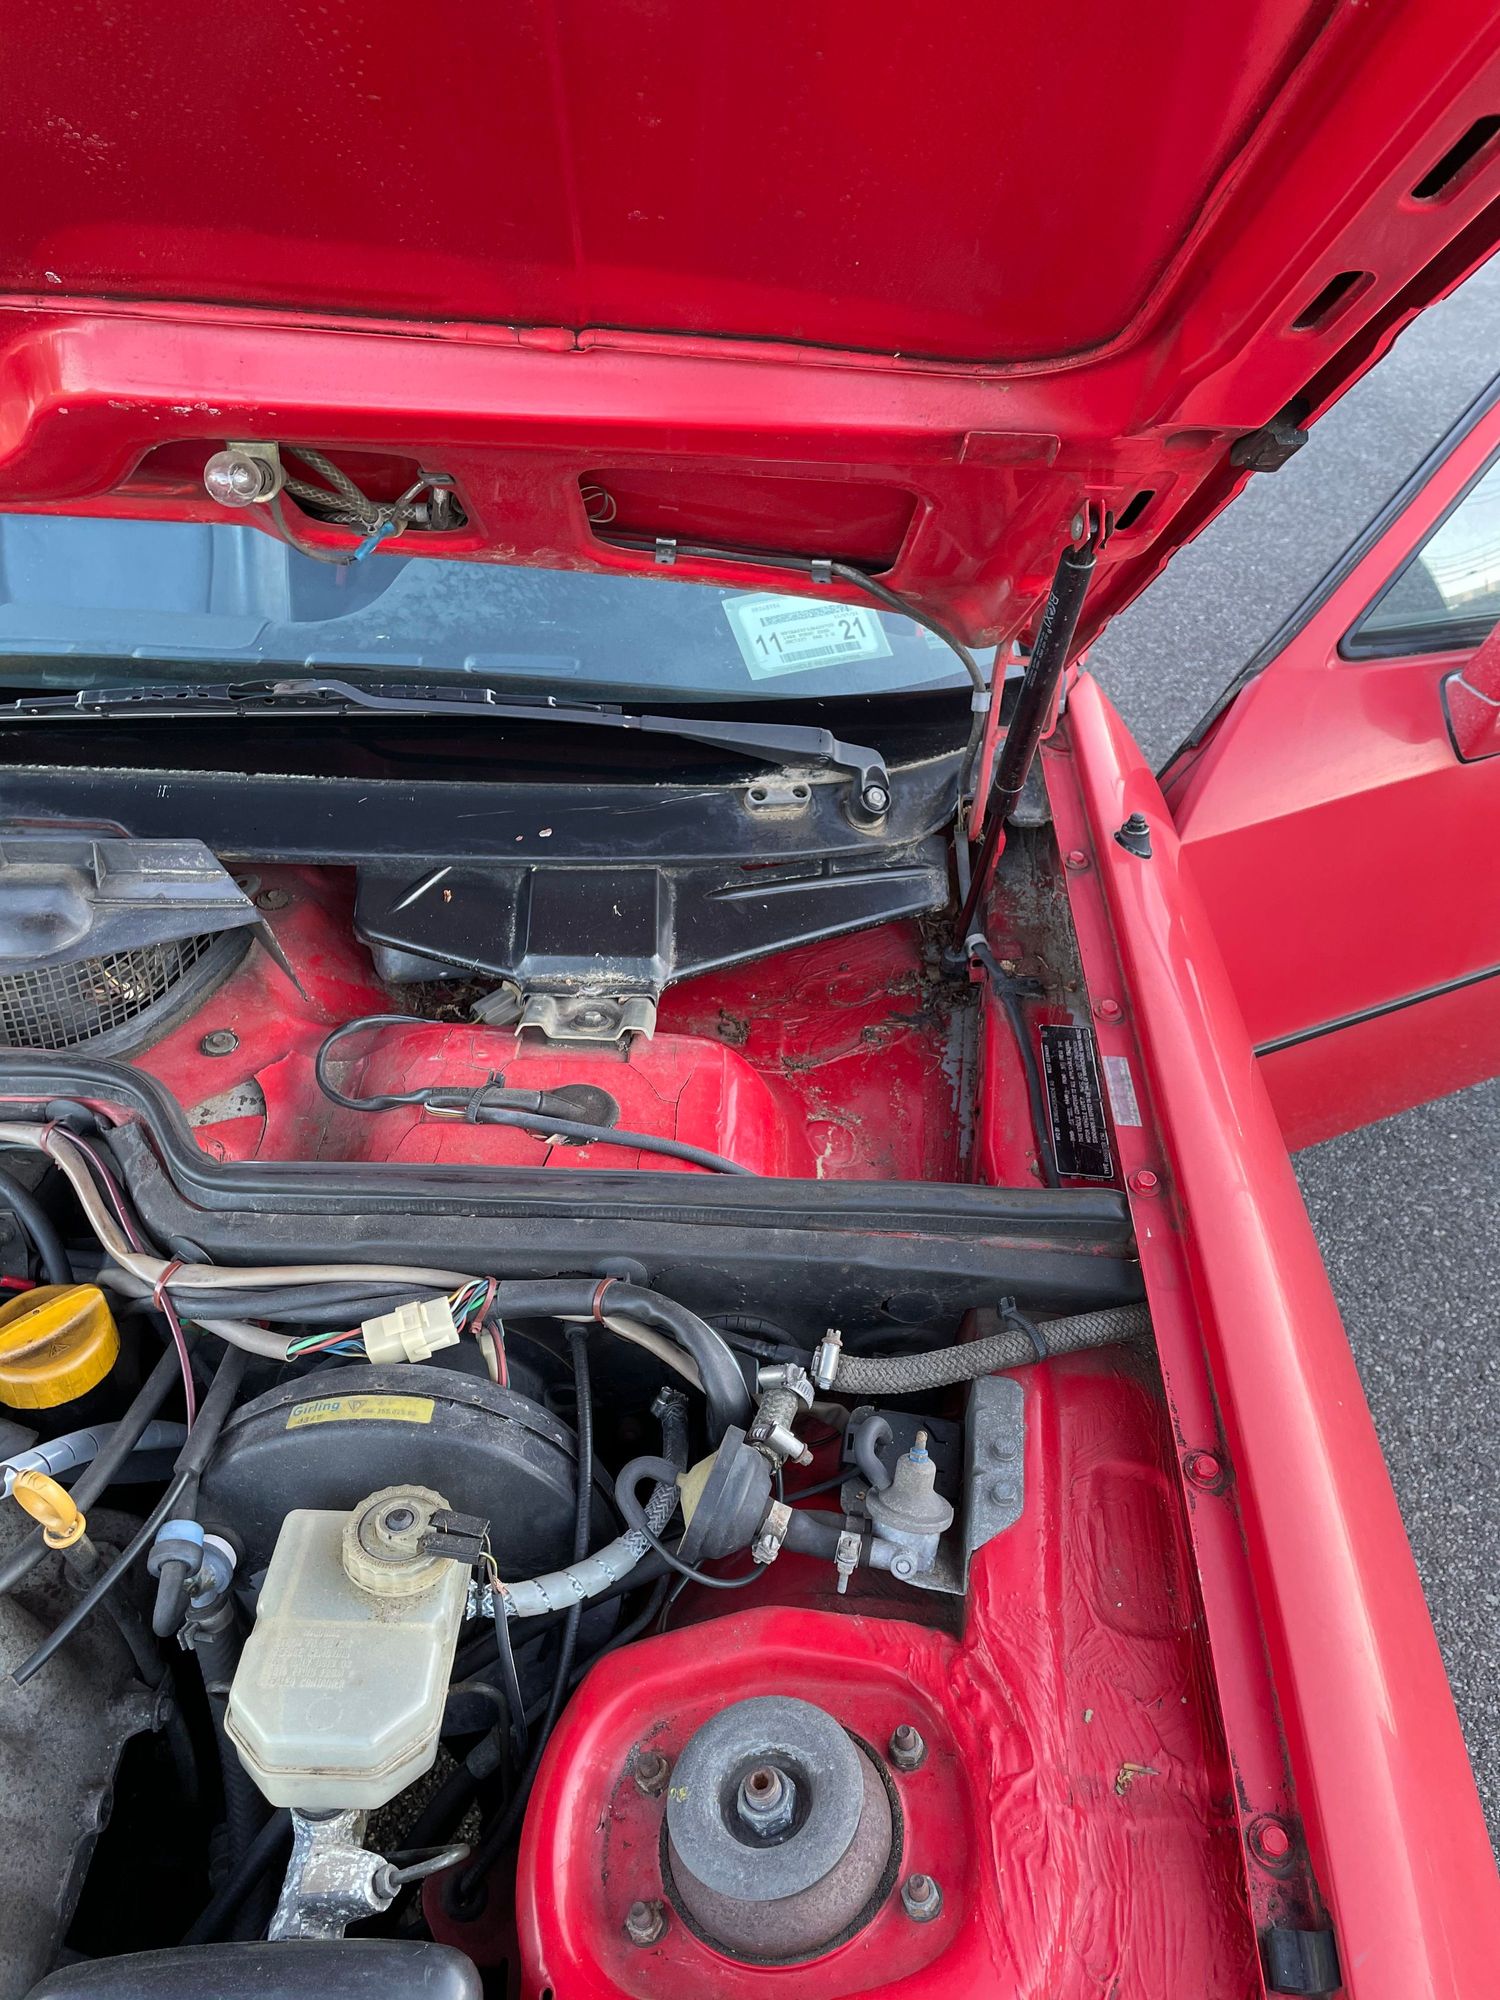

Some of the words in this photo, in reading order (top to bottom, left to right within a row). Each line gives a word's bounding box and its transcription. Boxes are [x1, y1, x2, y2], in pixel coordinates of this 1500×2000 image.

[837, 616, 867, 641] 21
[755, 631, 784, 656] 11
[293, 1401, 341, 1416] Girling
